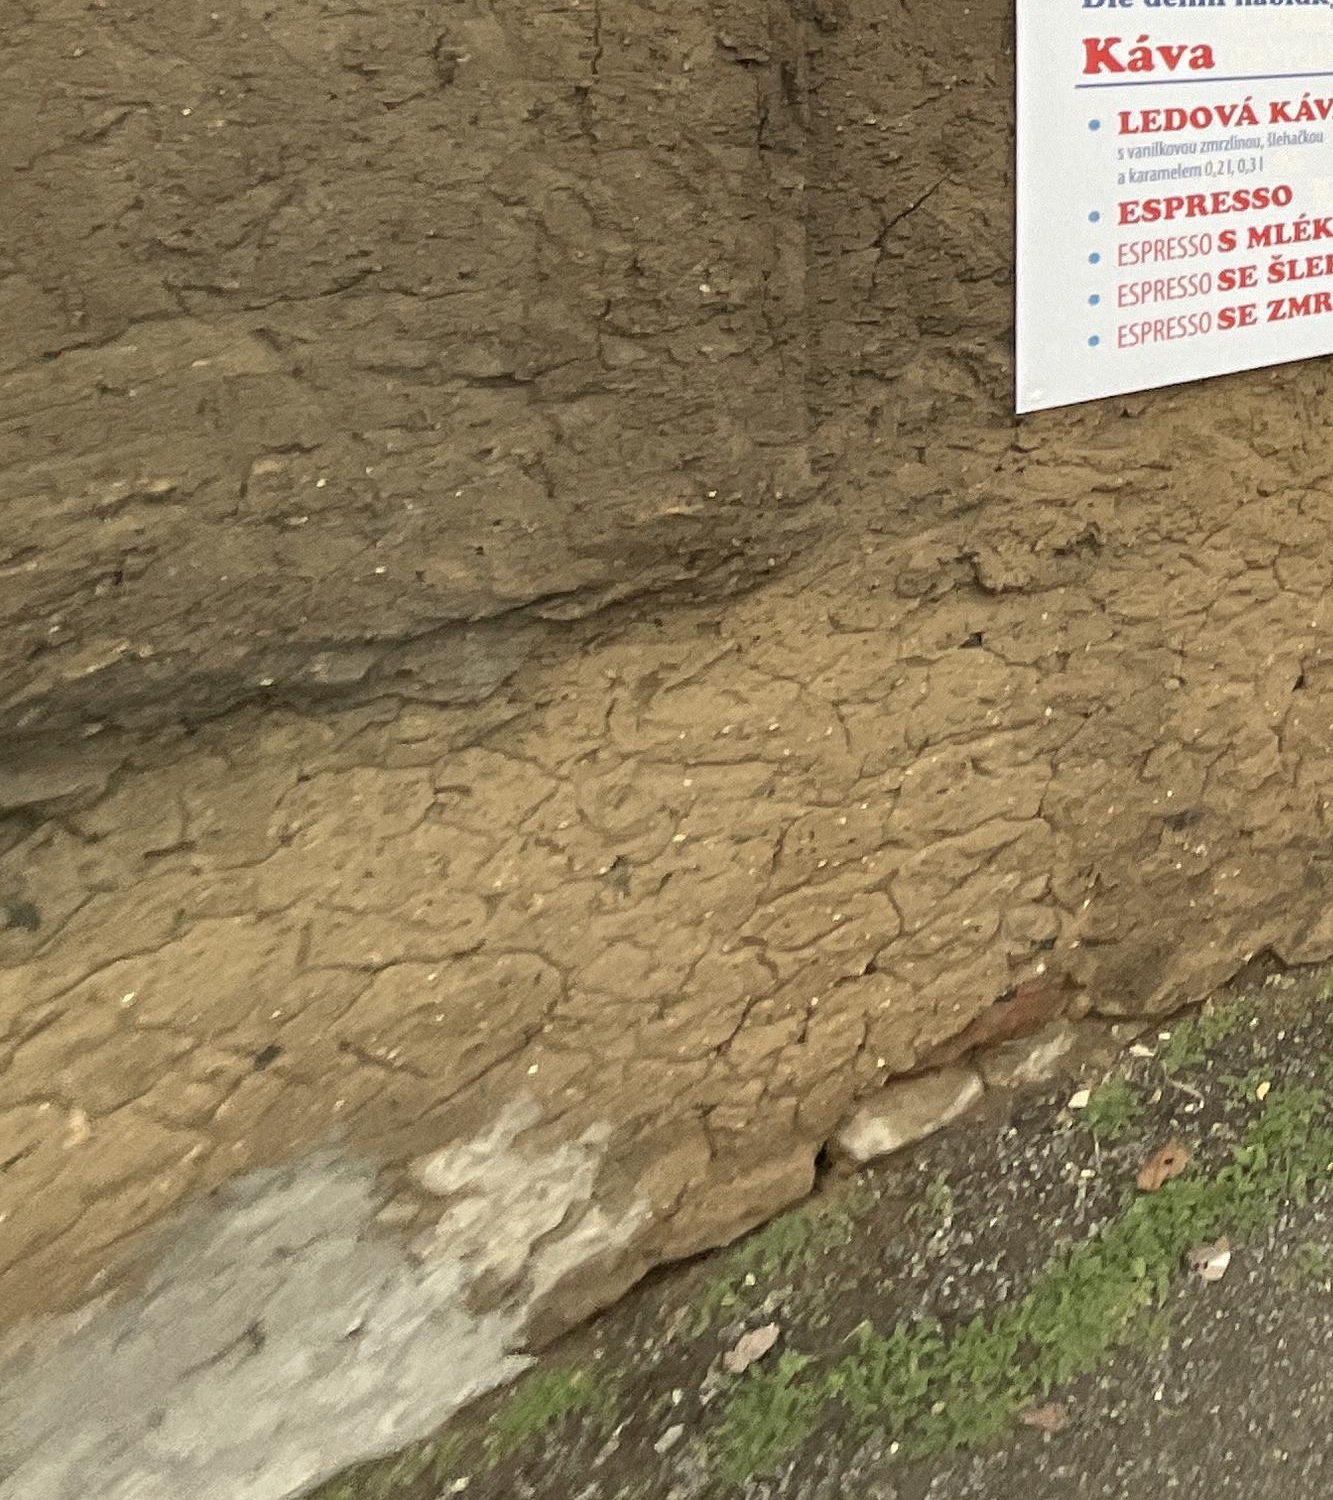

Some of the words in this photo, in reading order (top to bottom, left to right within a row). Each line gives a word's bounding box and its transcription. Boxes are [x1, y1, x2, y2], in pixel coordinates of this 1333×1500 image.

[1082, 34, 1216, 75] Káva
[1118, 97, 1260, 135] LEDOVÁ
[1118, 148, 1124, 160] s
[1127, 141, 1197, 159] vanilkovou
[1267, 130, 1323, 148] šlehačkou
[1117, 173, 1125, 185] a
[1129, 163, 1201, 184] karamelem
[1118, 184, 1293, 227] ESPRESSO
[1118, 233, 1212, 267] ESPRESSO
[1217, 229, 1237, 253] S
[1118, 273, 1212, 308] ESPRESSO
[1217, 265, 1258, 291] SE
[1118, 312, 1212, 349] ESPRESSO
[1217, 304, 1258, 331] SE
